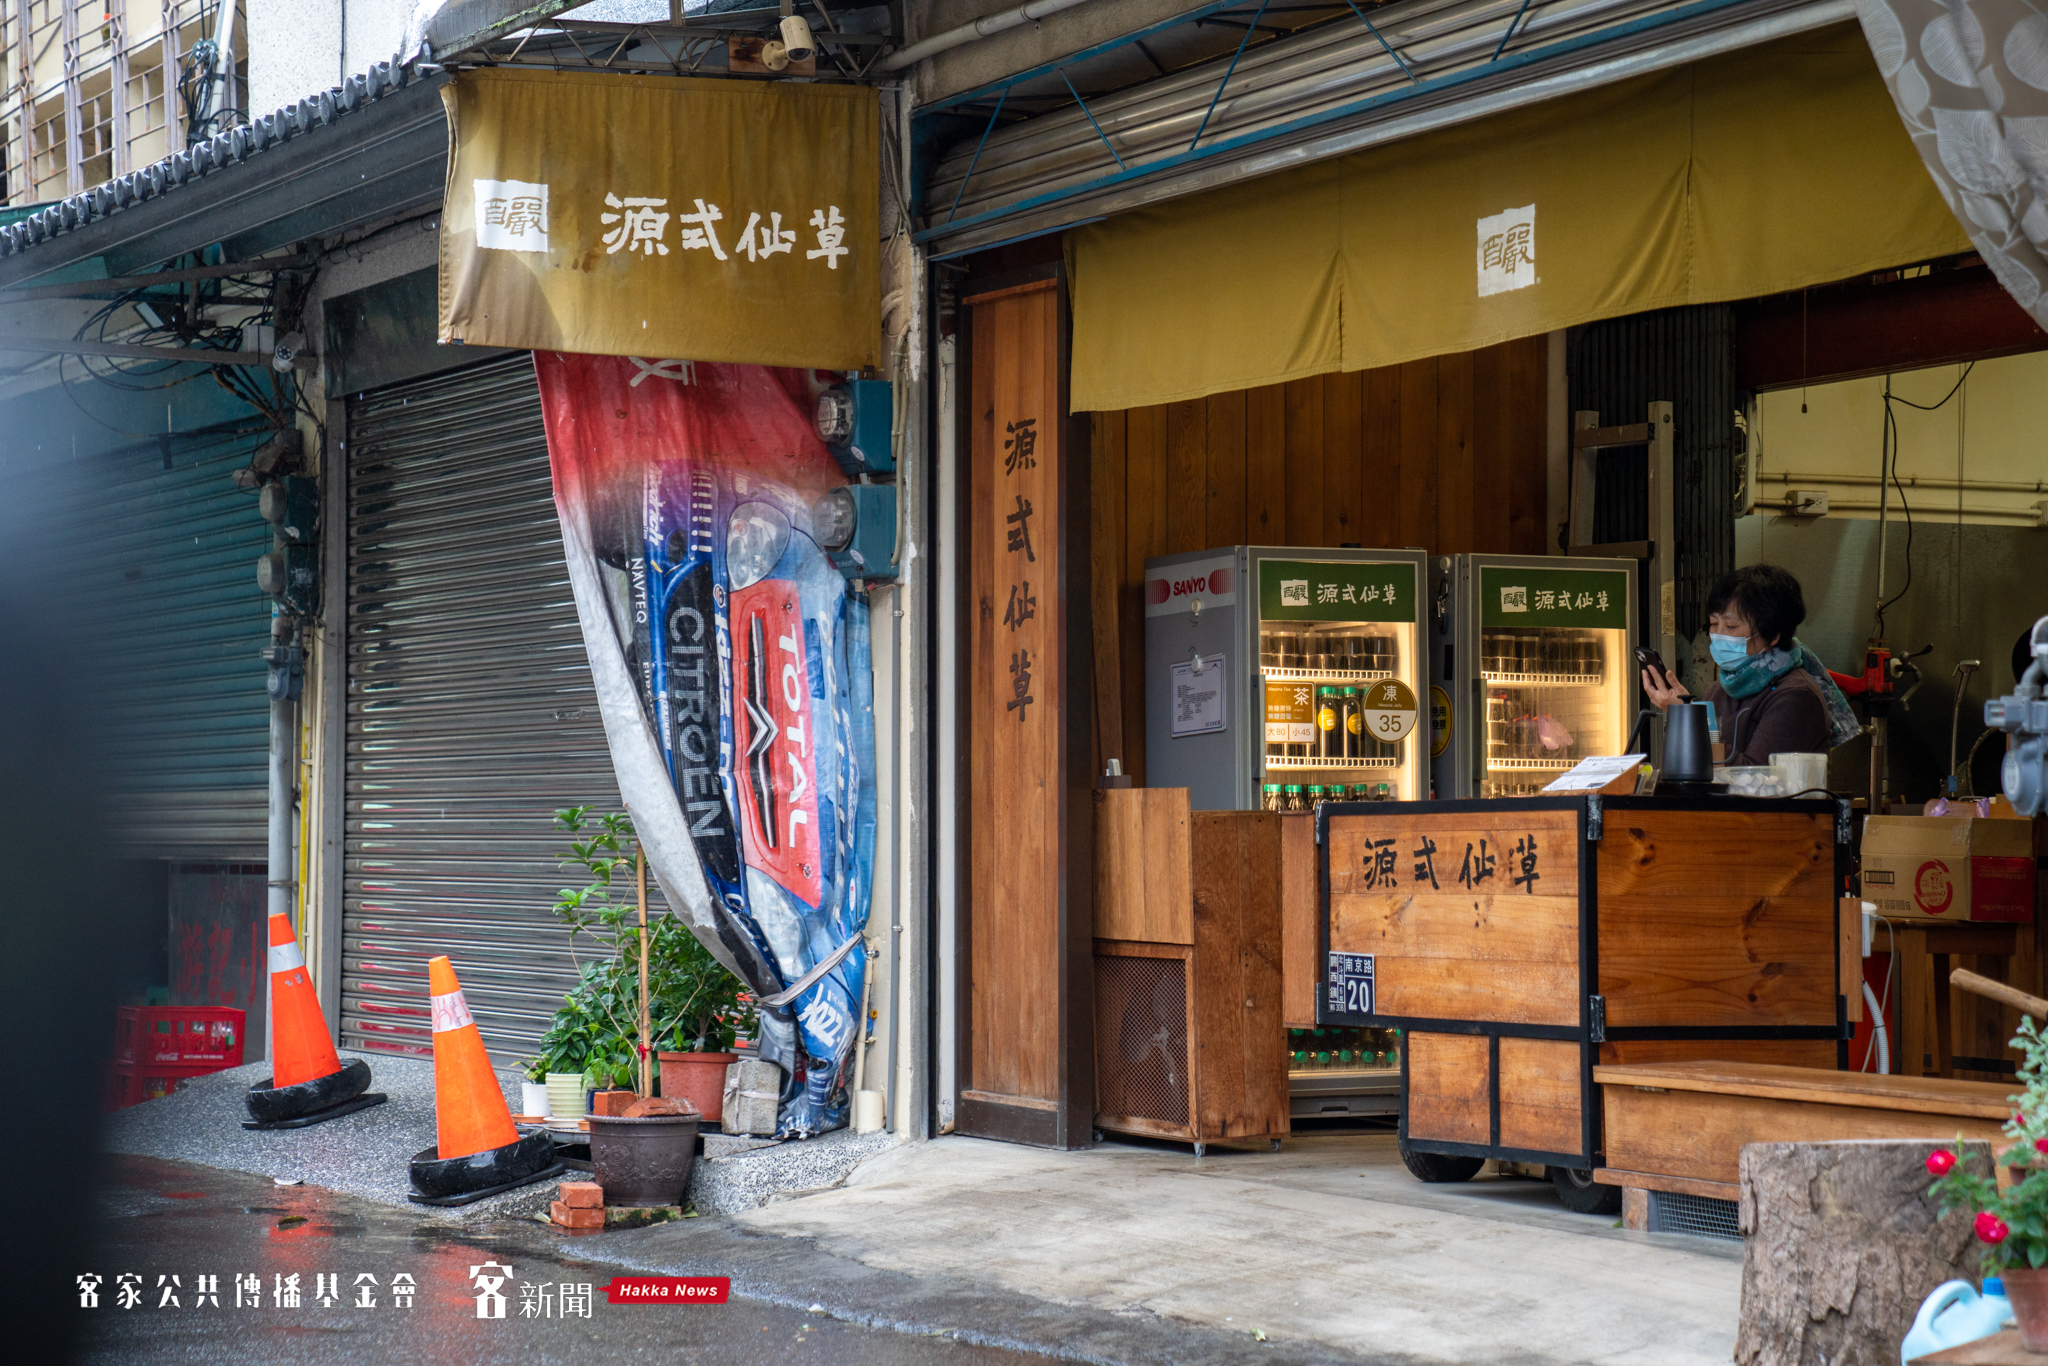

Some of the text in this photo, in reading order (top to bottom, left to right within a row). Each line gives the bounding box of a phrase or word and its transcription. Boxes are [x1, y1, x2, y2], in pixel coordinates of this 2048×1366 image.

[600, 191, 850, 269] 源式仙草
[1003, 418, 1037, 722] 源式仙草
[630, 557, 648, 624] NAVTEQ
[1173, 576, 1206, 598] SANYO
[1317, 583, 1396, 605] 源式仙草
[1535, 590, 1609, 612] 源式仙草
[1293, 687, 1310, 706] 茶
[1382, 685, 1398, 701] 凍
[1276, 728, 1286, 736] 80
[1300, 728, 1311, 736] 45
[1379, 714, 1402, 732] 35
[778, 622, 808, 849] TOTAL
[1363, 834, 1540, 894] 源式仙草
[1345, 957, 1372, 974] 南京路
[1347, 980, 1370, 1013] 20
[155, 1052, 180, 1062] Coca-Cola
